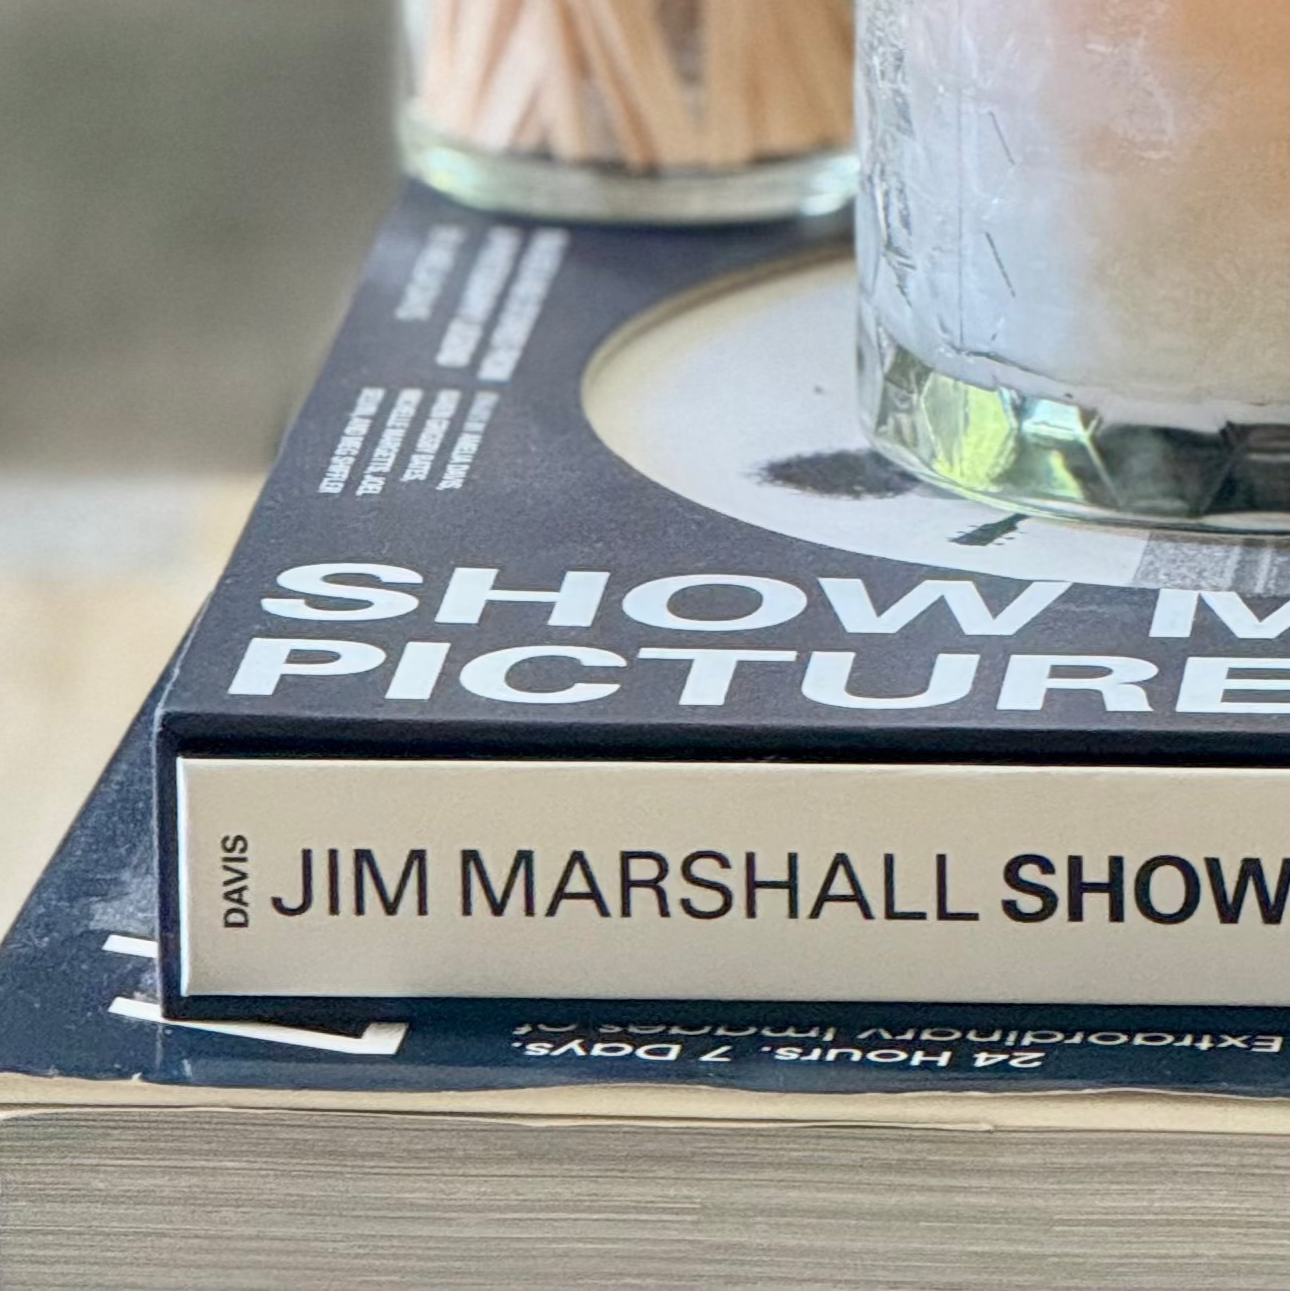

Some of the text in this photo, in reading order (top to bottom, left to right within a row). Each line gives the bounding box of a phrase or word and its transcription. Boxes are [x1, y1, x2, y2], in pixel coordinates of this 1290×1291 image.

[260, 562, 1069, 636] SHOW
[221, 834, 249, 928] DAVIS
[271, 848, 428, 917] JIM
[461, 849, 980, 922] MARSHALL
[510, 1038, 1047, 1069] 24 Hours. 7 Days.
